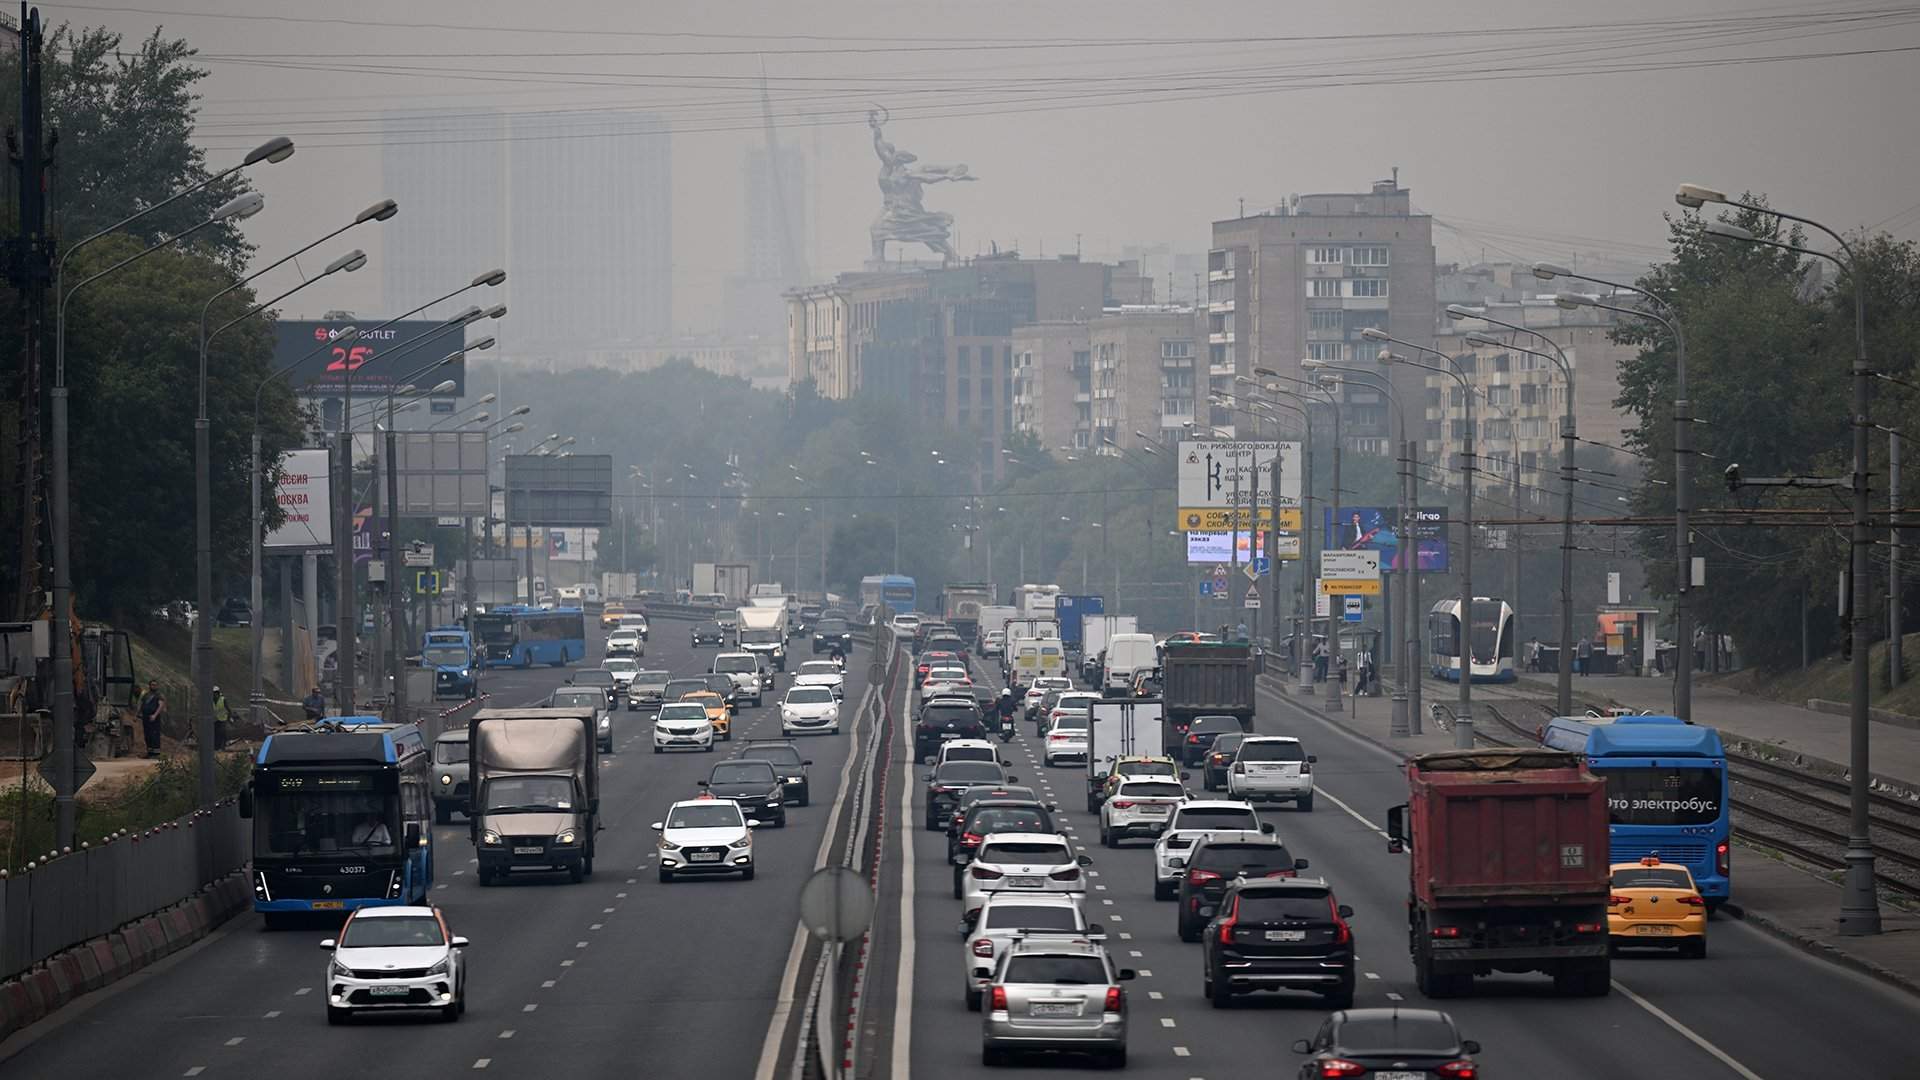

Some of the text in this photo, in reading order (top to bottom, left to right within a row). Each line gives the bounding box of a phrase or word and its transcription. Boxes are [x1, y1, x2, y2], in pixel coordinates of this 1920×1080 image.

[359, 330, 396, 340] OUTLET
[279, 474, 308, 485] ОССИЯ
[1632, 797, 1718, 813] электробус.
[340, 866, 366, 874] 430371
